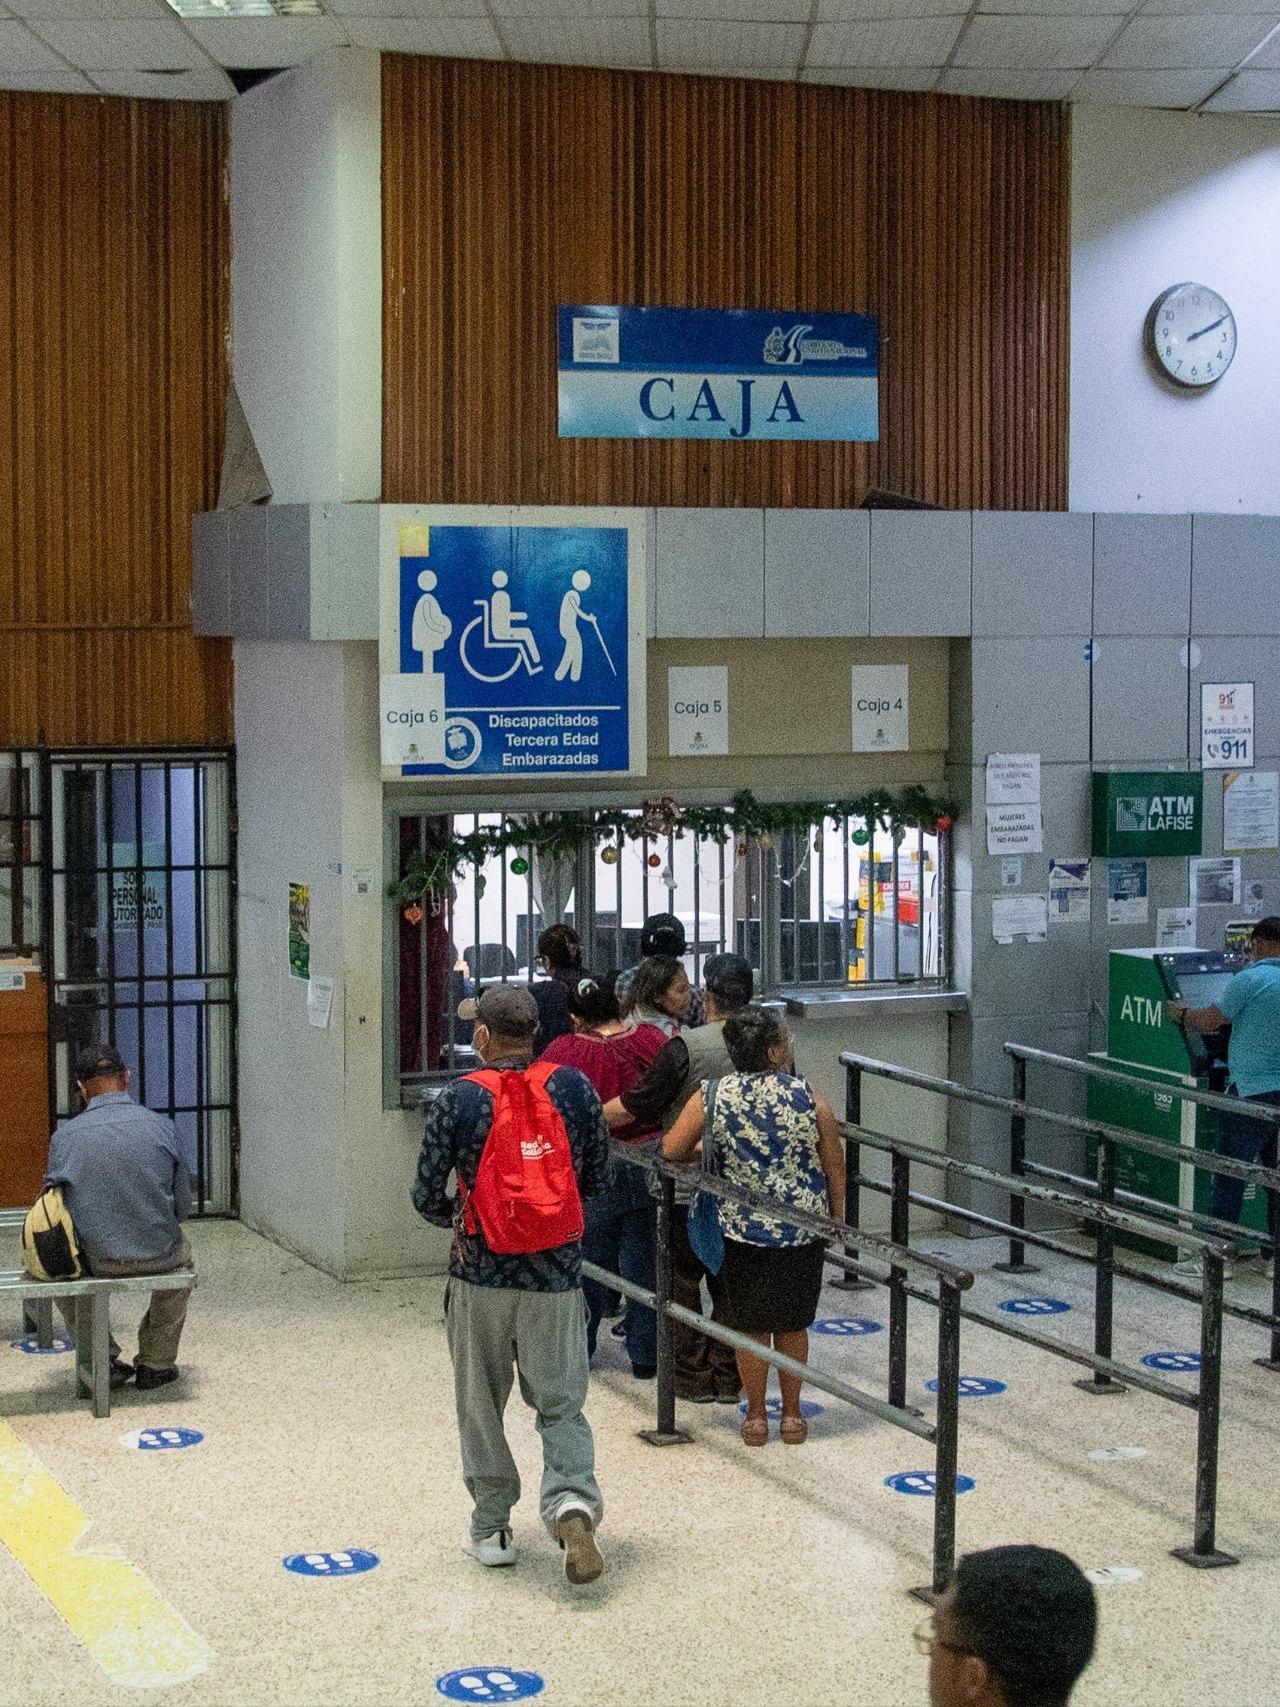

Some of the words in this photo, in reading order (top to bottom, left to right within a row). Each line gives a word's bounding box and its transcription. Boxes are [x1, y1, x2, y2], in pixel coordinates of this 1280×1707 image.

[639, 377, 805, 438] CAJA
[674, 700, 709, 717] Caja
[713, 700, 722, 714] 5
[857, 698, 890, 715] Caja
[893, 698, 904, 711] 4
[387, 710, 424, 728] Caja
[429, 709, 439, 724] 6
[488, 714, 599, 731] Discapacitados
[505, 733, 559, 747] Tercera
[562, 732, 599, 746] Edad
[1221, 740, 1248, 759] 911
[502, 752, 599, 766] Embarazadas
[1149, 796, 1194, 816] ATM
[1147, 816, 1194, 831] LAFISE
[123, 871, 147, 885] SOO
[1120, 994, 1162, 1028] ATM
